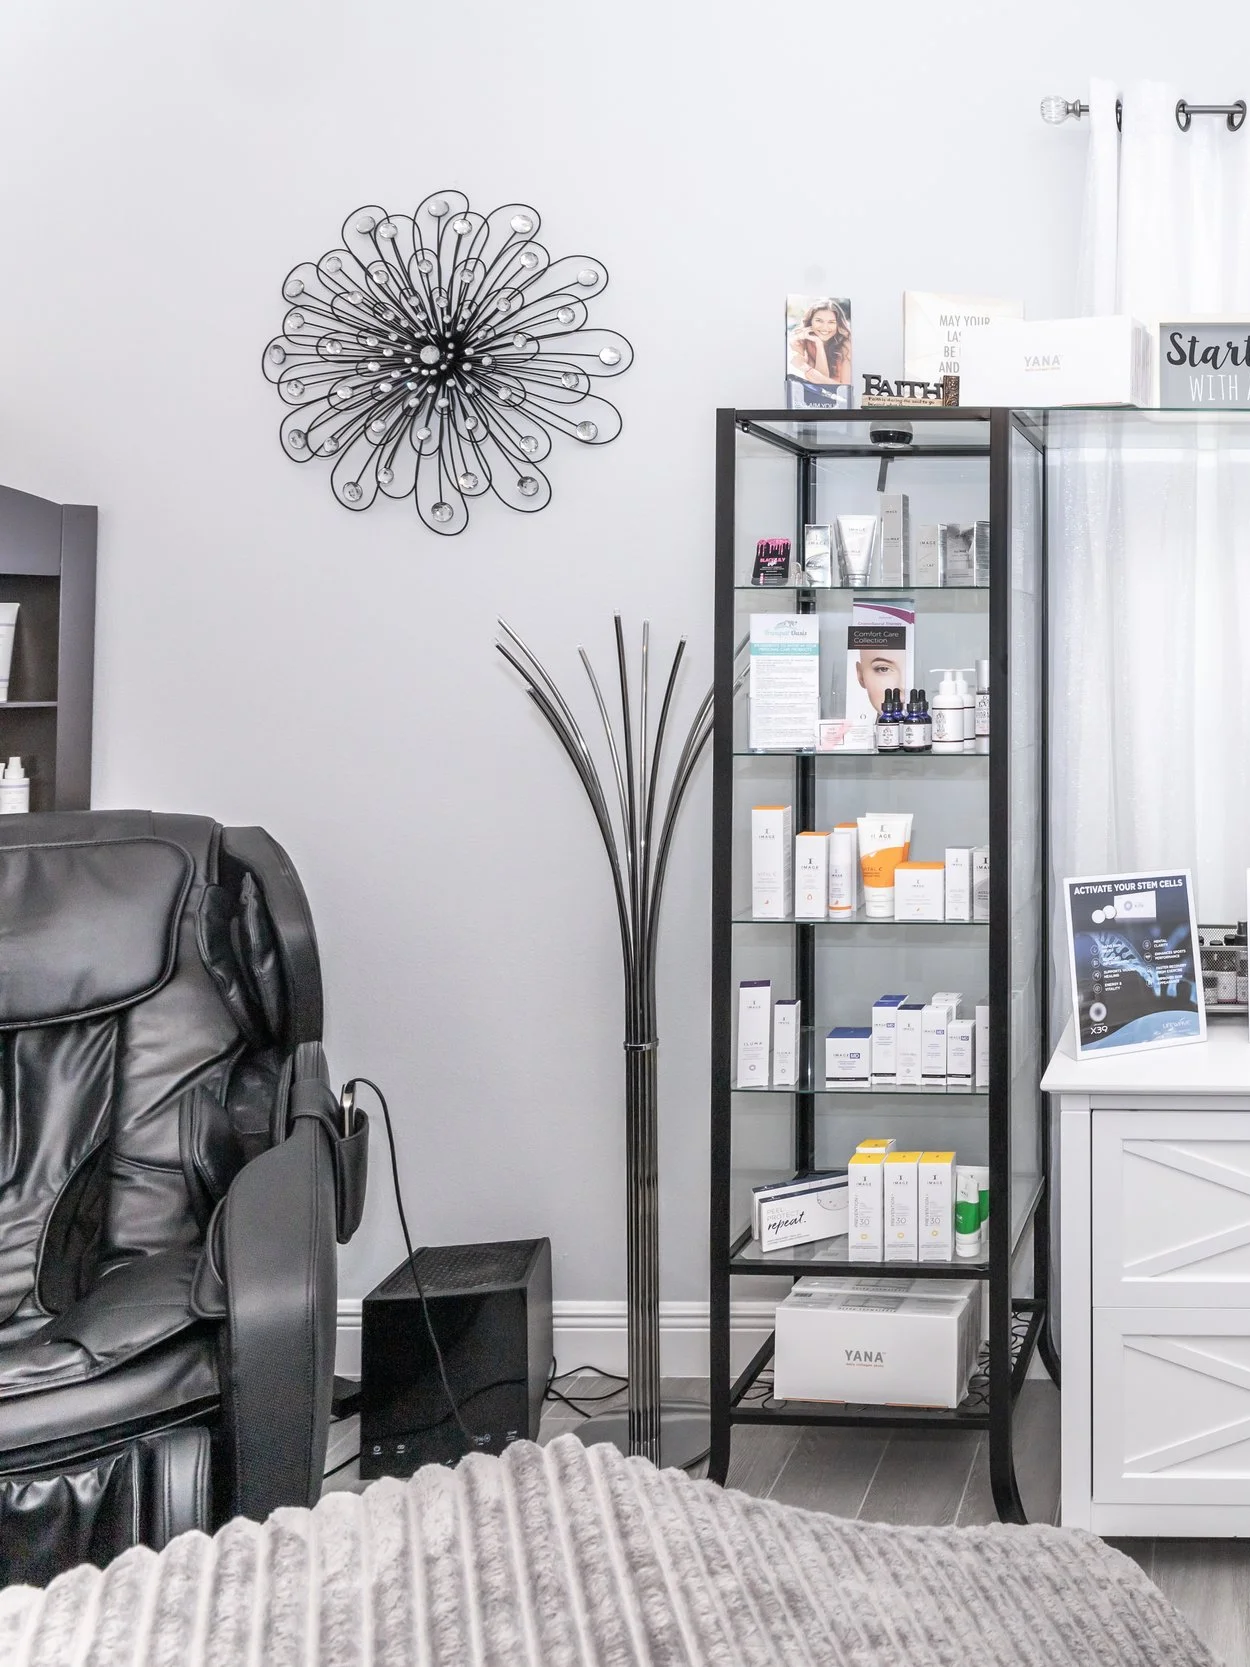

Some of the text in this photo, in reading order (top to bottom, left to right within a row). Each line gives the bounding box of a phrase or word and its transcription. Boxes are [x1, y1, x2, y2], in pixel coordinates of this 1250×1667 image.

[939, 315, 960, 327] MAY
[1024, 355, 1061, 367] YANA
[939, 362, 960, 374] AND
[862, 373, 945, 400] FAITH
[1189, 375, 1238, 402] WITH
[1073, 879, 1183, 895] ACTIVATE YOUR STEM CELLS
[1090, 1026, 1108, 1035] X39
[767, 1210, 807, 1235] repeat.
[859, 1218, 870, 1226] 30
[845, 1349, 883, 1363] YANA
